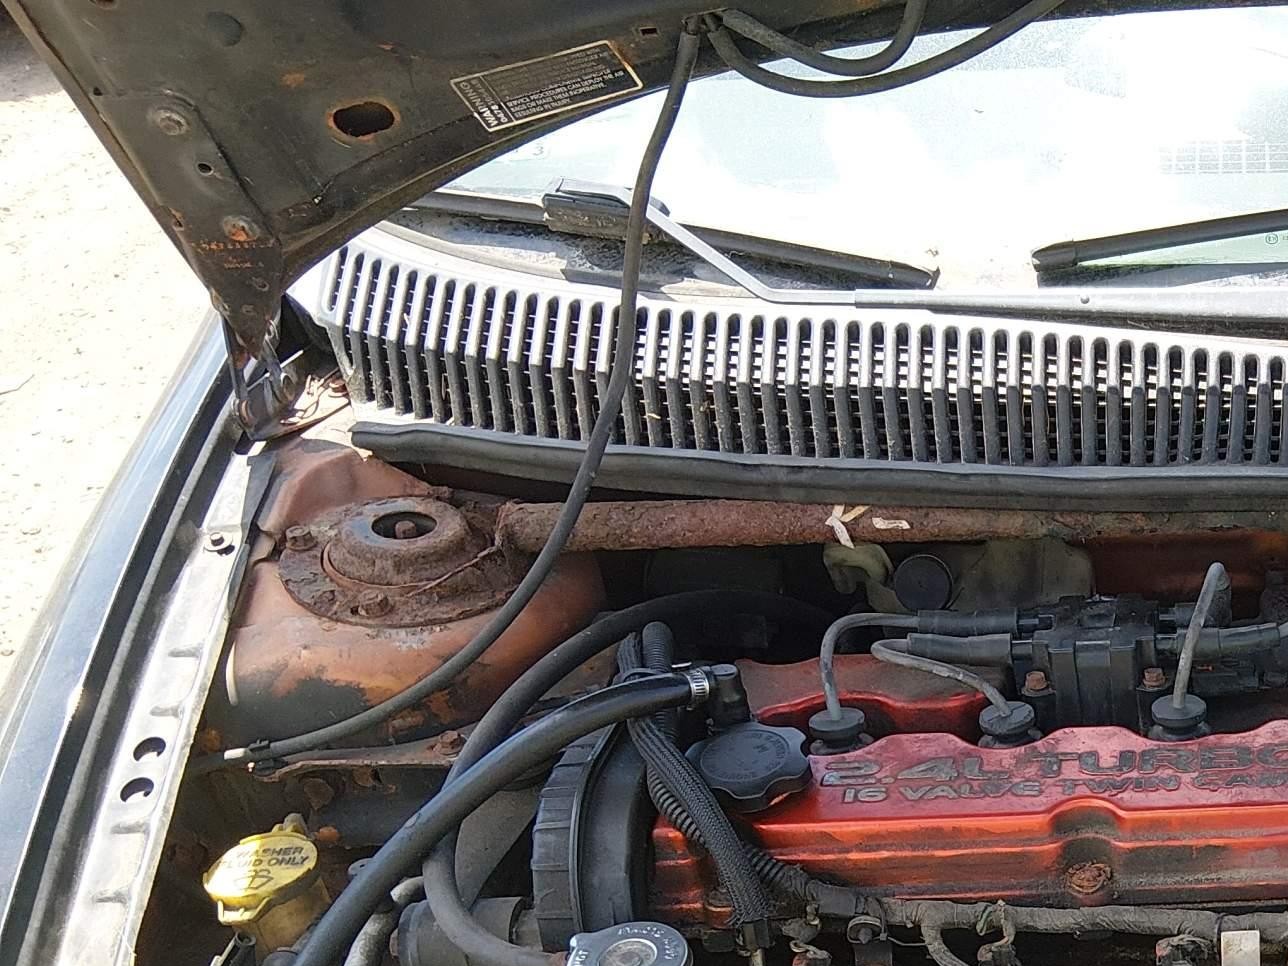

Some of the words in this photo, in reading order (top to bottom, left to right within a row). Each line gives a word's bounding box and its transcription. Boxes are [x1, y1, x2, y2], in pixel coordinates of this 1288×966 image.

[459, 81, 500, 127] WARNING
[820, 754, 1010, 787] 2.4L
[842, 785, 890, 804] 16
[898, 780, 1042, 802] VALVE
[1060, 774, 1180, 794] TWIN
[267, 855, 310, 867] ONLY
